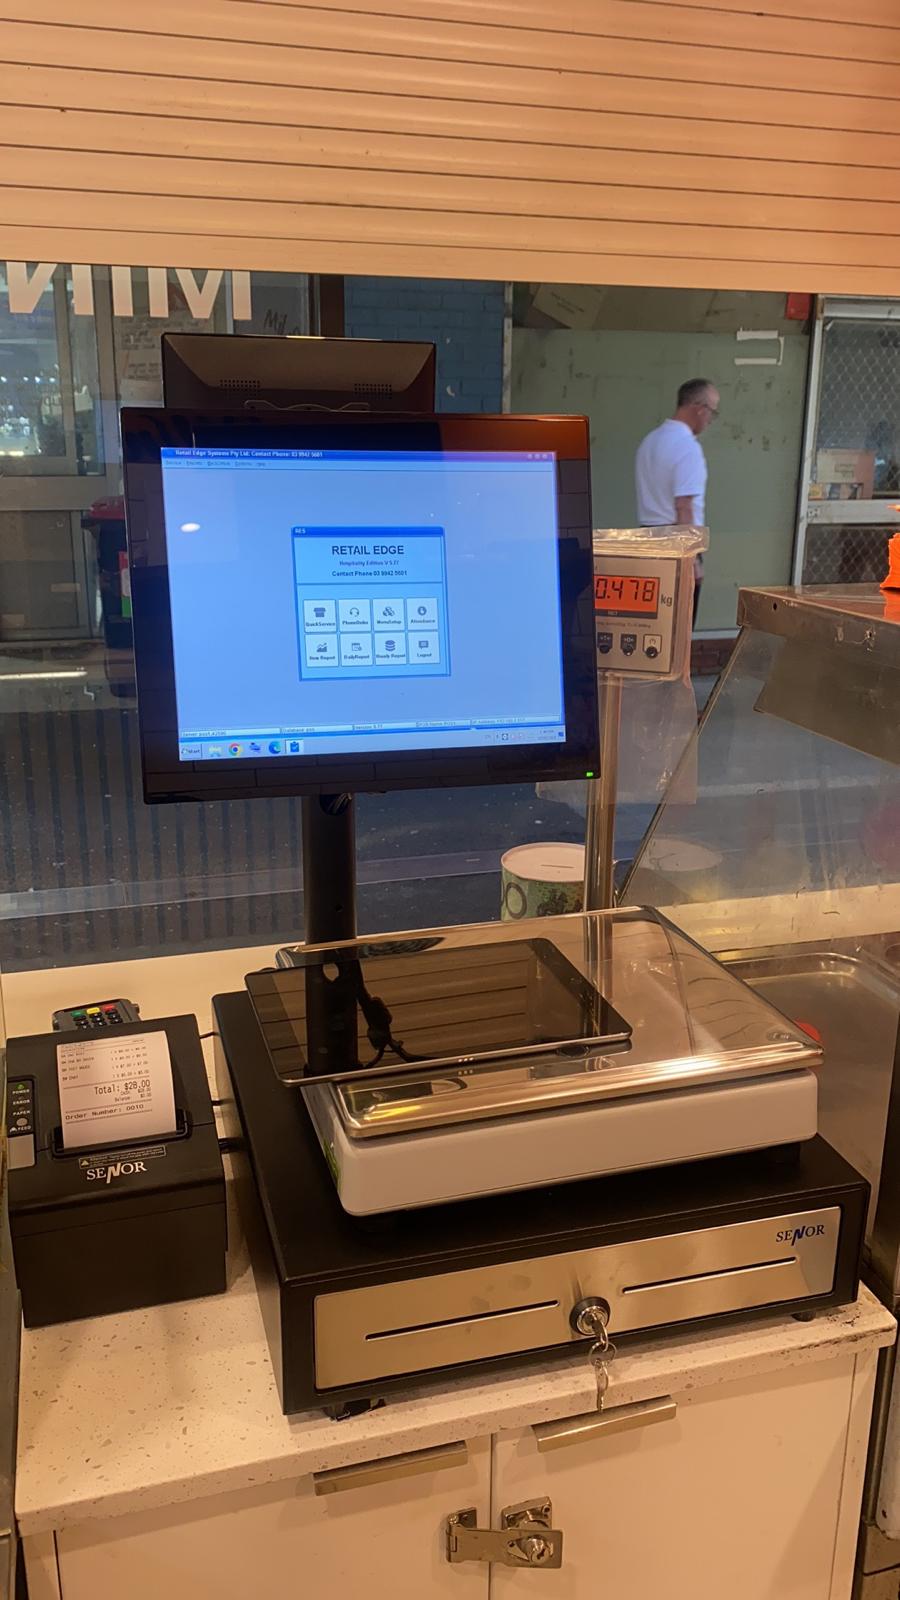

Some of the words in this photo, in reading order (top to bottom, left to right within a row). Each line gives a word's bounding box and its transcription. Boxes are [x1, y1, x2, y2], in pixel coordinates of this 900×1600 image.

[332, 545, 370, 555] RETAIL
[373, 545, 405, 555] EDGE
[660, 594, 672, 606] kg
[94, 1084, 120, 1095] Total:
[124, 1080, 150, 1090] $28.00
[92, 1108, 122, 1116] Number:
[86, 1161, 147, 1184] SENOR
[776, 1224, 824, 1246] SENOR
